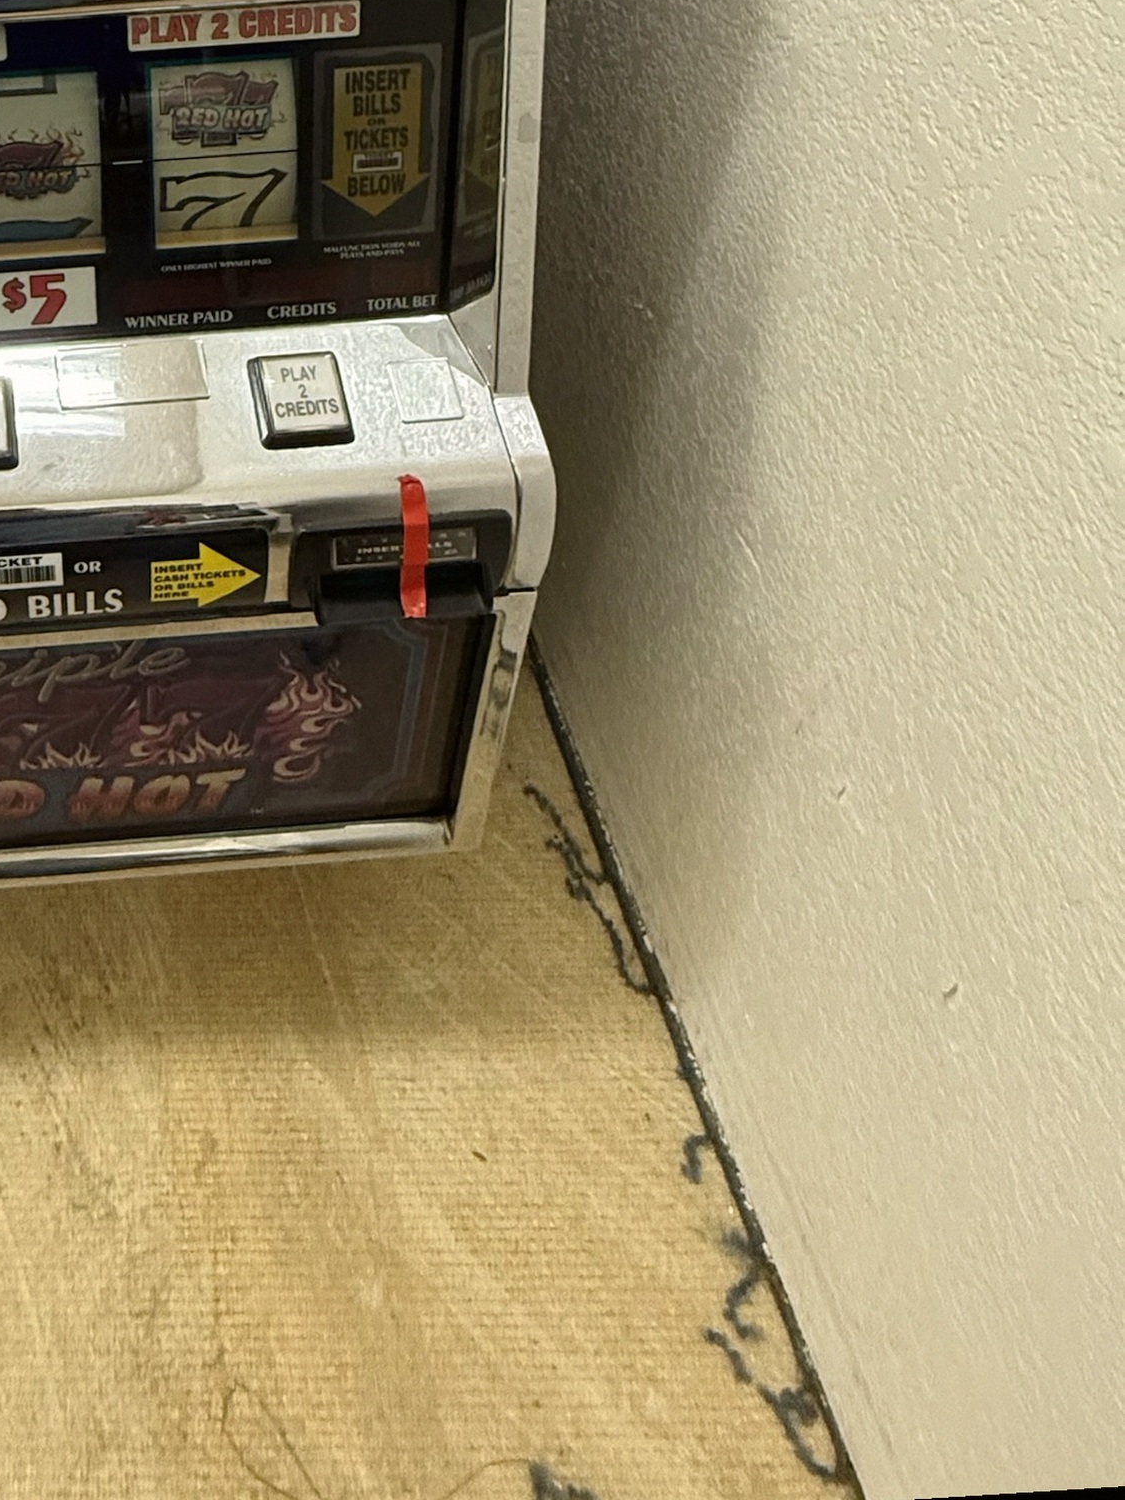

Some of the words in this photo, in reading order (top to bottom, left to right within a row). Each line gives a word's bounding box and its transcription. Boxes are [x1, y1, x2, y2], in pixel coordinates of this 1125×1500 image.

[131, 15, 202, 45] PLAY
[211, 13, 229, 39] 2
[238, 4, 357, 38] CREDITS
[345, 68, 411, 91] INSERT
[353, 93, 401, 116] BILLS
[176, 108, 219, 128] RED
[222, 108, 268, 128] HOT
[367, 118, 386, 126] OR
[344, 128, 409, 152] TICKETS
[347, 175, 405, 198] BELOW
[2, 274, 67, 326] $5
[367, 297, 408, 311] TOTAL
[413, 294, 437, 309] BET
[126, 311, 189, 329] WINNER
[193, 309, 233, 325] PAID
[267, 302, 337, 319] CREDITS
[280, 366, 317, 383] PLAY
[298, 384, 308, 398] 2
[274, 399, 339, 418] CREDITS
[74, 560, 102, 574] OR
[154, 563, 203, 573] INSERT
[154, 573, 189, 583] CASH
[191, 570, 246, 580] TICKETS
[154, 583, 175, 592] OR
[178, 581, 215, 591] BILLS
[28, 588, 123, 618] BILLS
[63, 768, 245, 817] HOT
